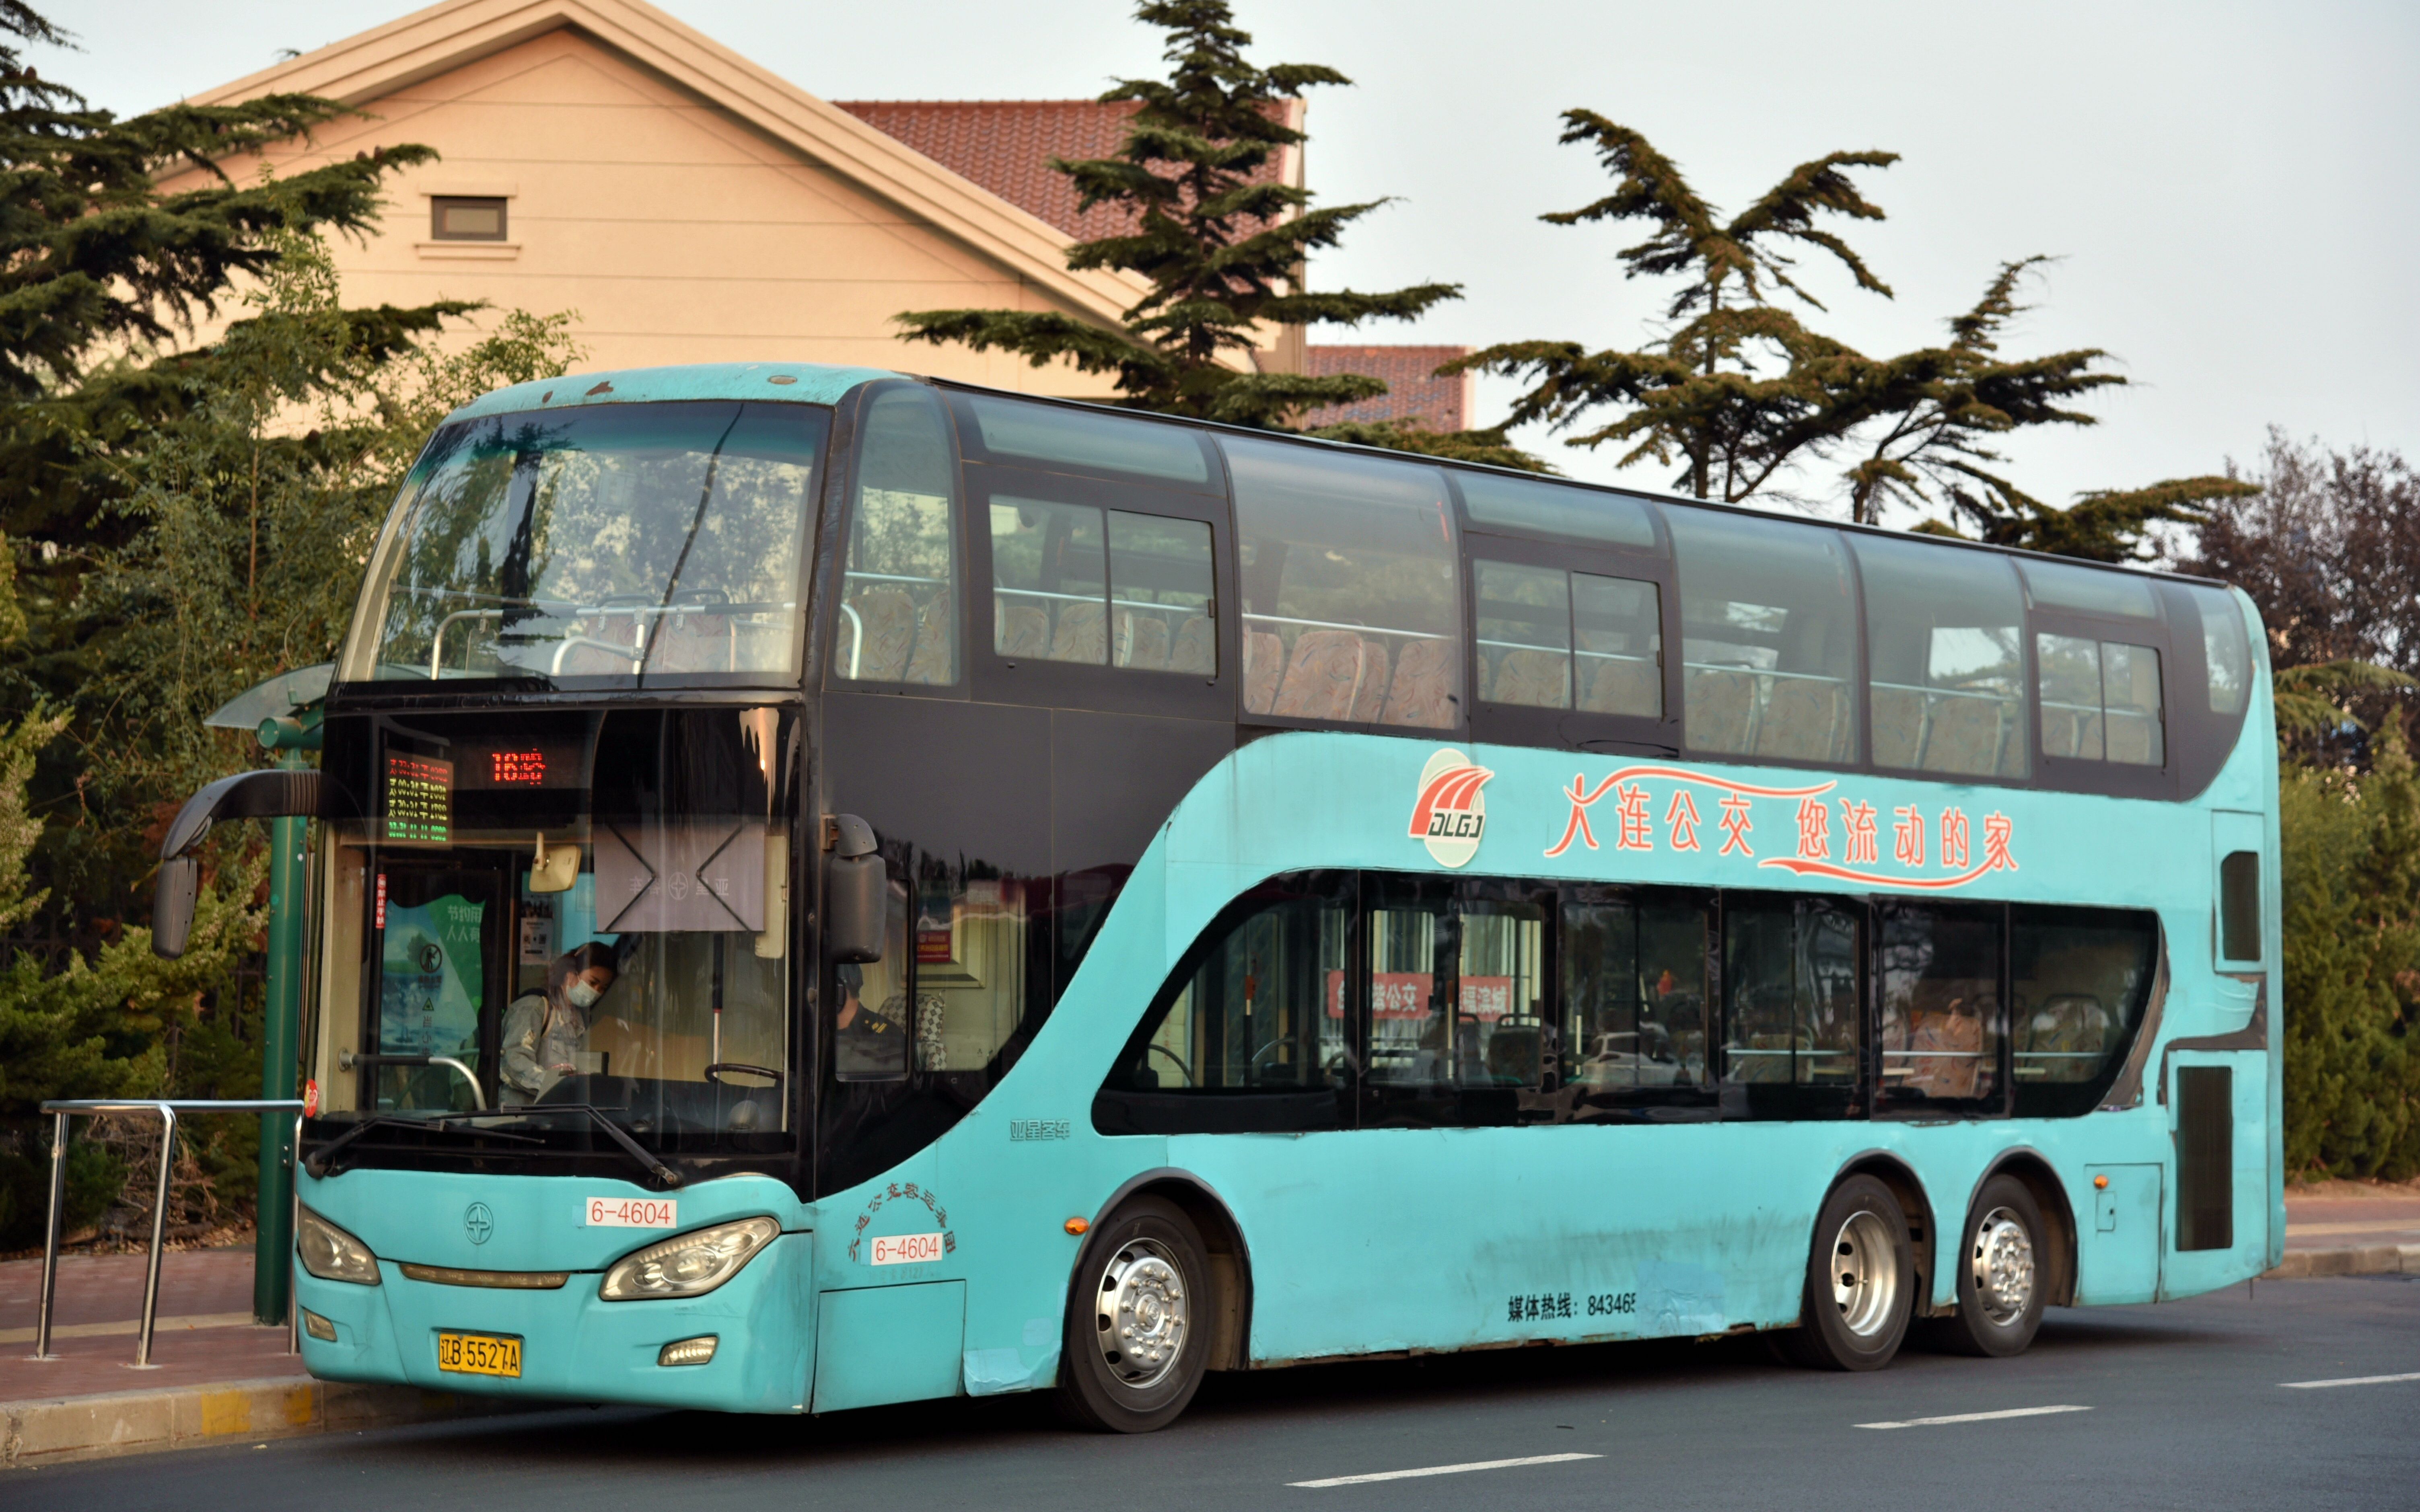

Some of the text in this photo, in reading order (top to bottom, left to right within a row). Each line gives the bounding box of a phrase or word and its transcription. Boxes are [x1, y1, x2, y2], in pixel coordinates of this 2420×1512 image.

[1544, 766, 2019, 871] 大连公交 您流动的家
[1010, 1119, 1070, 1141] 亚星客车
[592, 1200, 671, 1224] 6-4604
[875, 1236, 938, 1261] 6-4604
